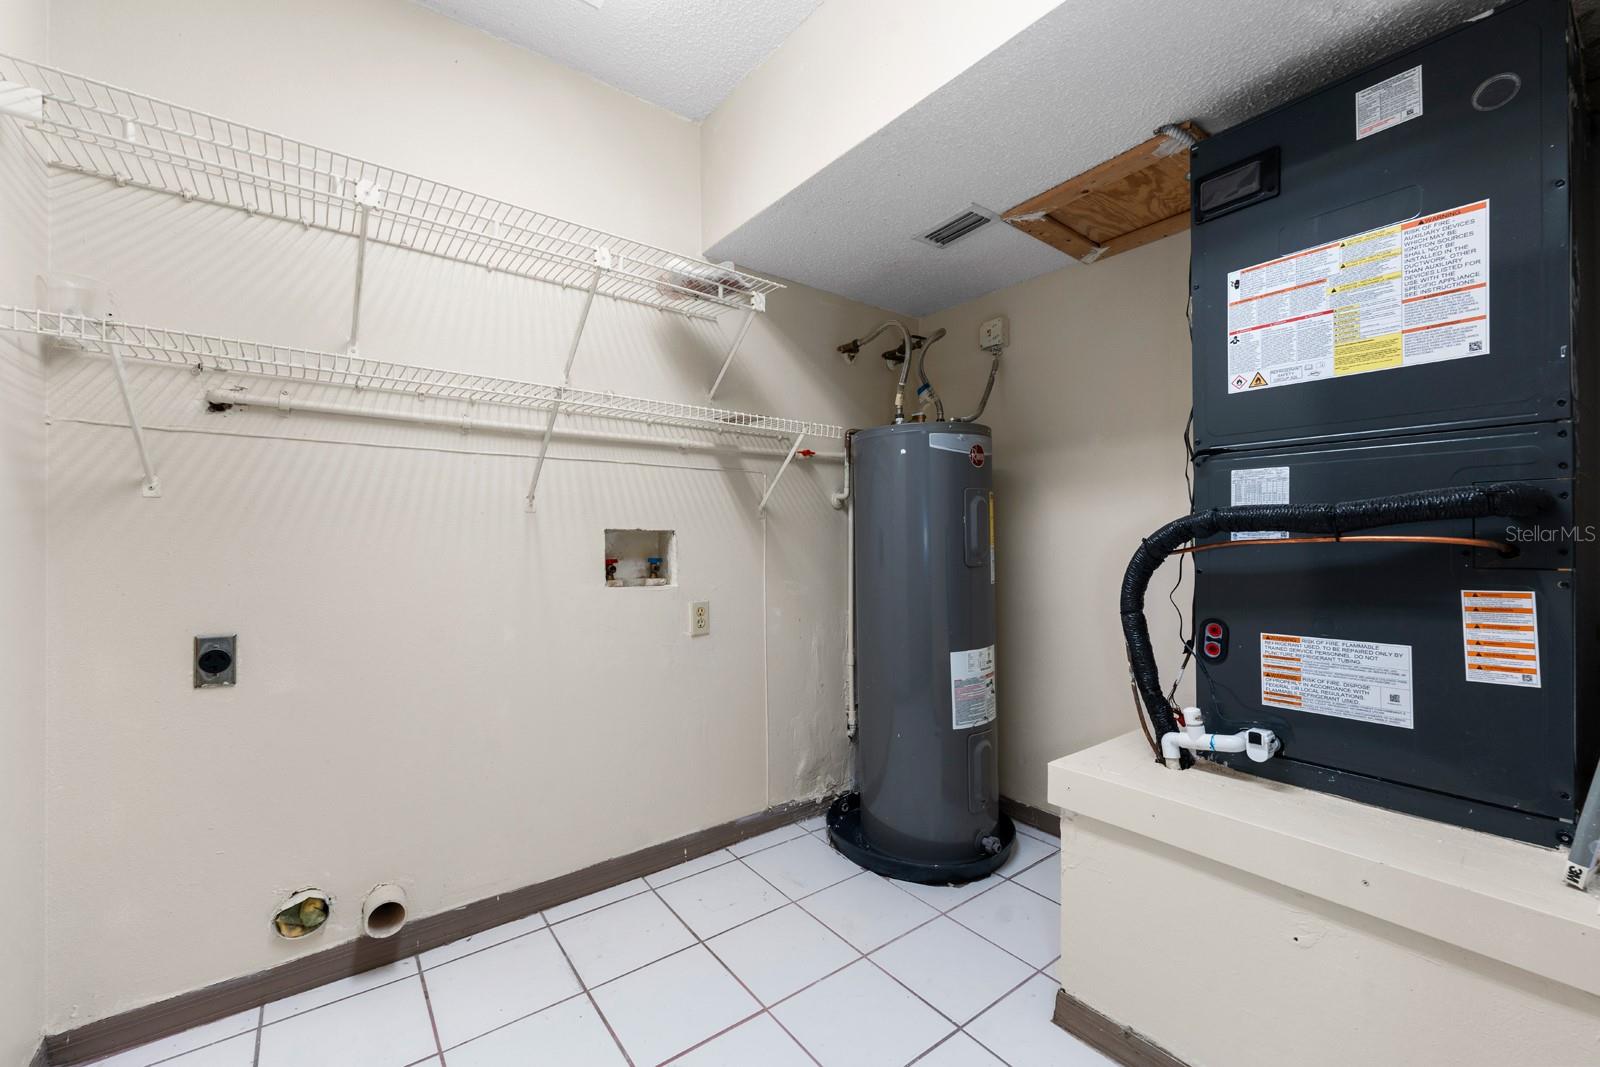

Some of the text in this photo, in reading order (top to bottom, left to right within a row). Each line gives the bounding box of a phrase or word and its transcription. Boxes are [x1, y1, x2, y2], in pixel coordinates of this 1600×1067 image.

[1425, 211, 1461, 223] WARNING
[1404, 219, 1476, 241] AUXILIARY DEVICES
[1404, 231, 1474, 252] IGNITION SOURCES
[1404, 237, 1428, 247] WHICH
[1404, 249, 1426, 258] SHALL
[1405, 251, 1442, 263] INSTALLED
[1450, 248, 1476, 258] OTHER
[1404, 259, 1481, 280] DEVICES LISTED FOR
[1405, 258, 1462, 275] THAN AUXILIARY
[1421, 275, 1439, 283] WITH
[1405, 282, 1437, 292] SPECIFIC
[1265, 640, 1302, 648] REFRIGERANT
[1295, 653, 1336, 663] REFRIGERANT
[1310, 684, 1351, 692] ACCORDANCE
[1344, 682, 1370, 690] DISPOSE
[1265, 687, 1298, 695] FLAMMABLE
[1300, 692, 1340, 702] REFRIGERANT
[1567, 866, 1583, 884] 3M
